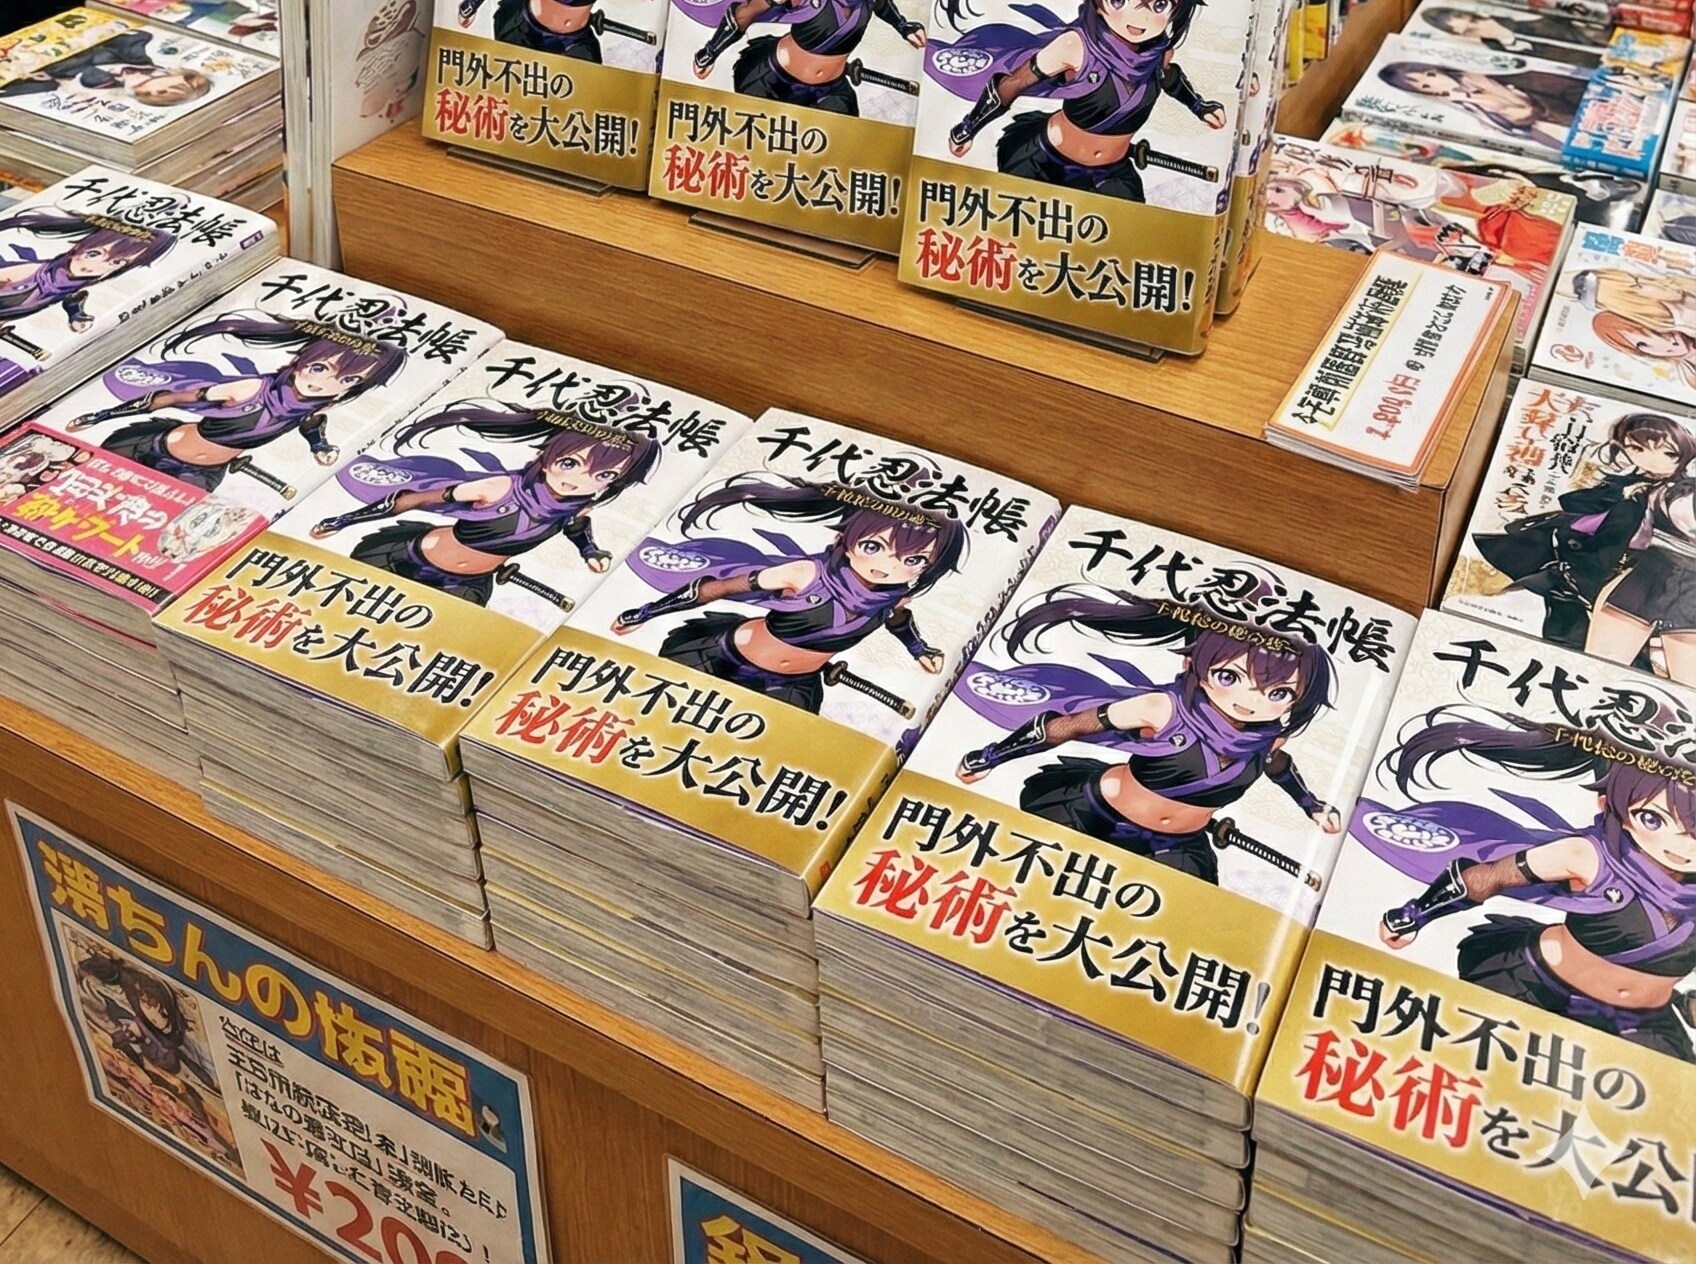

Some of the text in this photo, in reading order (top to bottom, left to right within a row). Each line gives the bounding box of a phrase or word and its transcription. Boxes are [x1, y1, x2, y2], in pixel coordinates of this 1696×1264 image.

[434, 88, 640, 157] 秘術を大公開!
[438, 48, 574, 99] 門外不出の
[668, 100, 828, 155] 門外不出の
[65, 178, 248, 247] 千代忍法帳
[663, 144, 901, 217] 秘術を大公開!
[919, 179, 1109, 244] 門外不出の
[261, 274, 478, 364] 千代忍法帳
[916, 227, 1195, 313] 秘術を大公開!
[485, 356, 727, 459] 千代忍法帳
[756, 426, 1031, 543] 千代忍法帳
[226, 548, 432, 629] 門外不出の
[1068, 529, 1396, 673] 千代忍法帳
[183, 585, 495, 708] 秘術を大公開!
[531, 646, 766, 740] 門外不出の
[495, 690, 849, 832] 秘術を大公開!
[882, 798, 1161, 919] 門外不出の
[854, 849, 1271, 1036] 秘術を大公開!
[1312, 963, 1647, 1111] 門外不出の
[1296, 1030, 1696, 1224] 秘術を大公
[260, 1138, 470, 1264] ¥20
